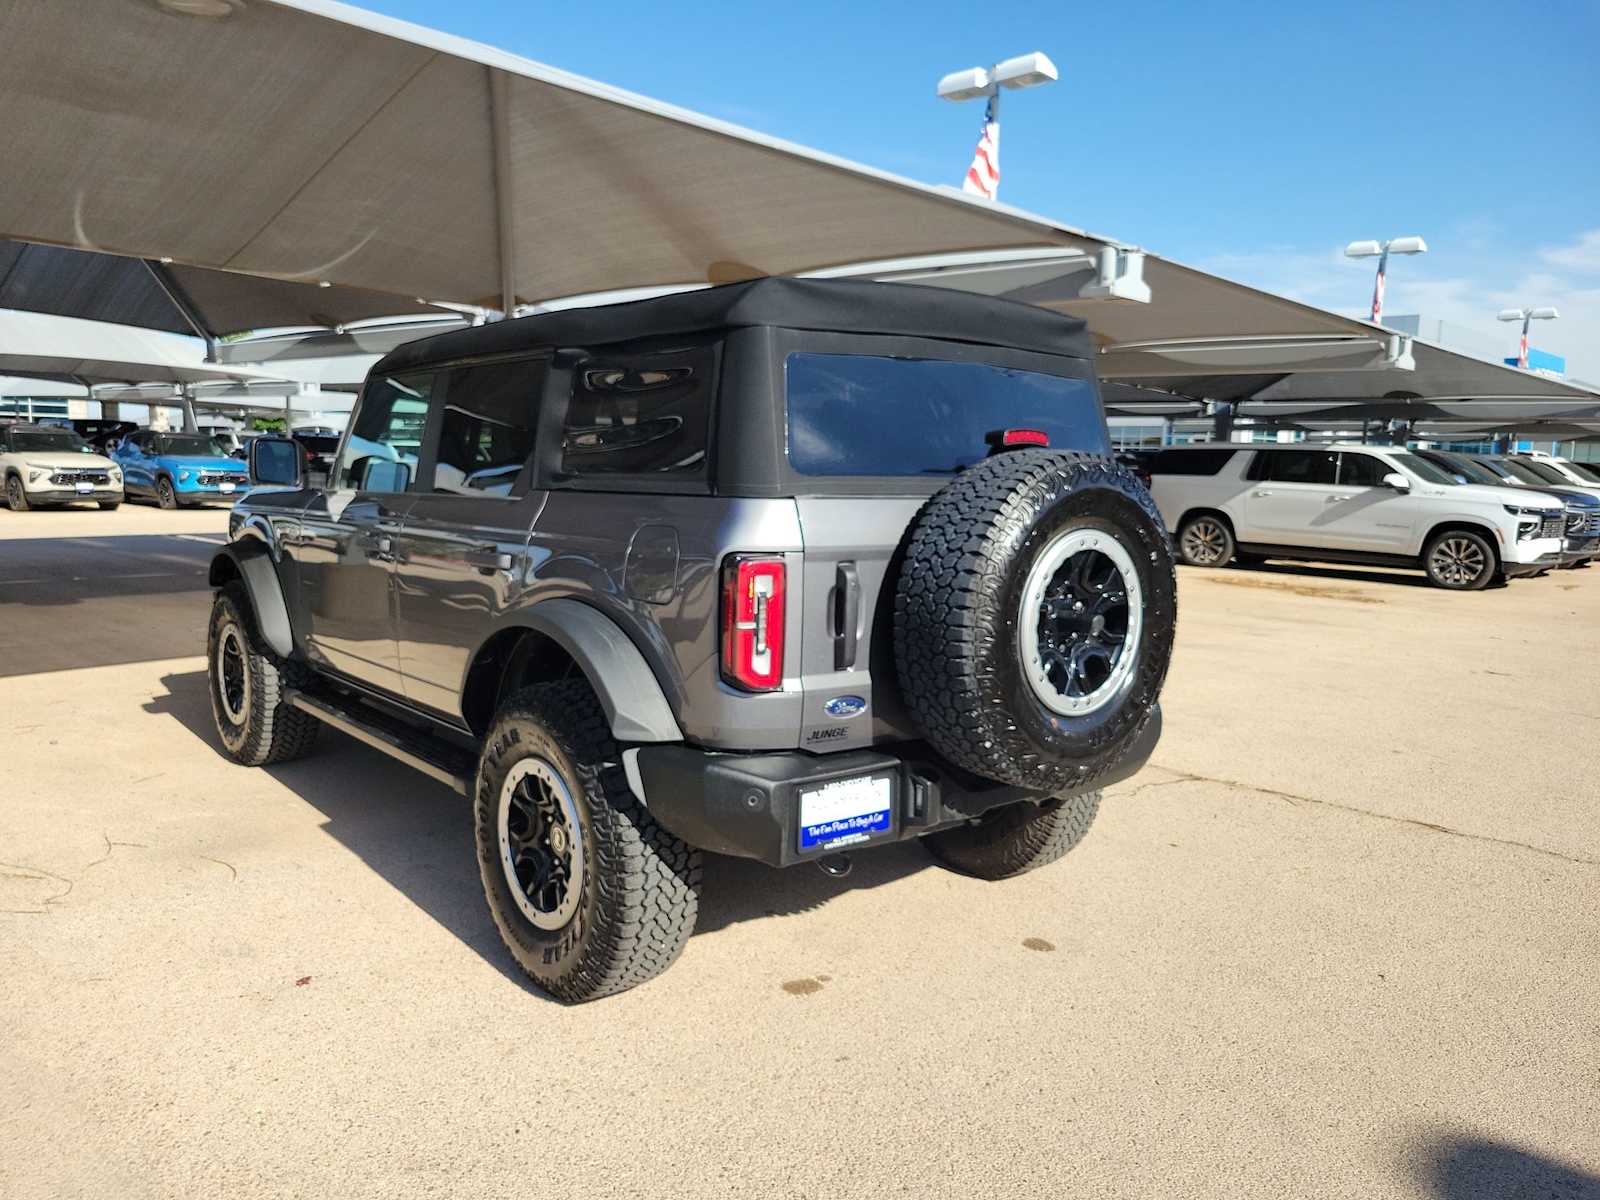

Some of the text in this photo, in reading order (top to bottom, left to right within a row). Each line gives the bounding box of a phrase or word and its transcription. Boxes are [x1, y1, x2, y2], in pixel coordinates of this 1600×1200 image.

[806, 726, 849, 741] JUNGE
[808, 826, 820, 837] The
[832, 821, 849, 833] Place
[874, 812, 884, 823] Car
